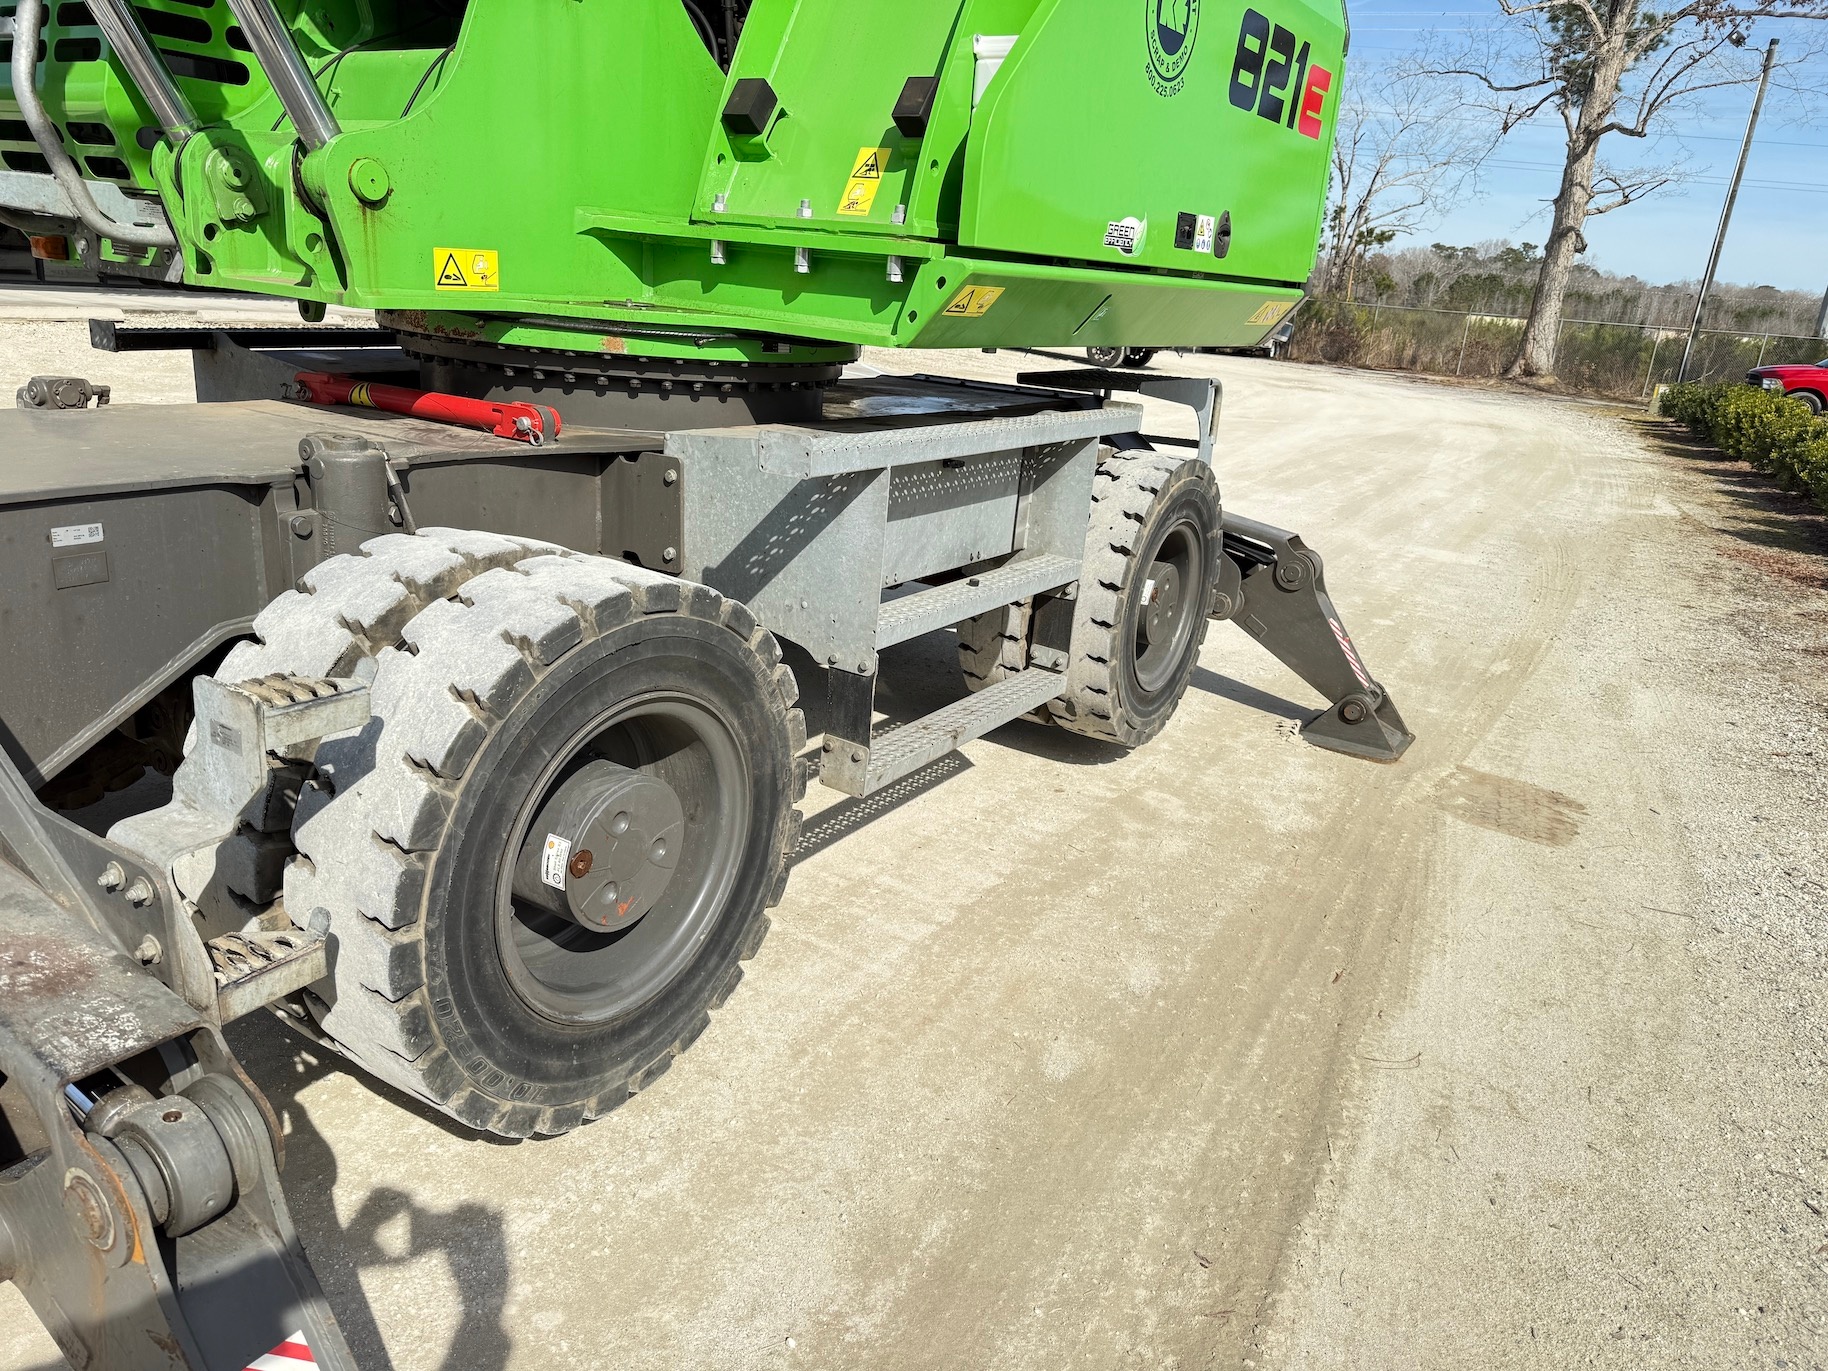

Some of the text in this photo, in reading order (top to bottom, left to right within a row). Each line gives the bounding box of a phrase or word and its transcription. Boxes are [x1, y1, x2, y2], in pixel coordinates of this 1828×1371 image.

[1150, 29, 1188, 73] SCRAP & DEMO
[1145, 62, 1185, 98] 800.225.0623
[1228, 8, 1332, 141] 821E
[1108, 224, 1135, 237] GREEN
